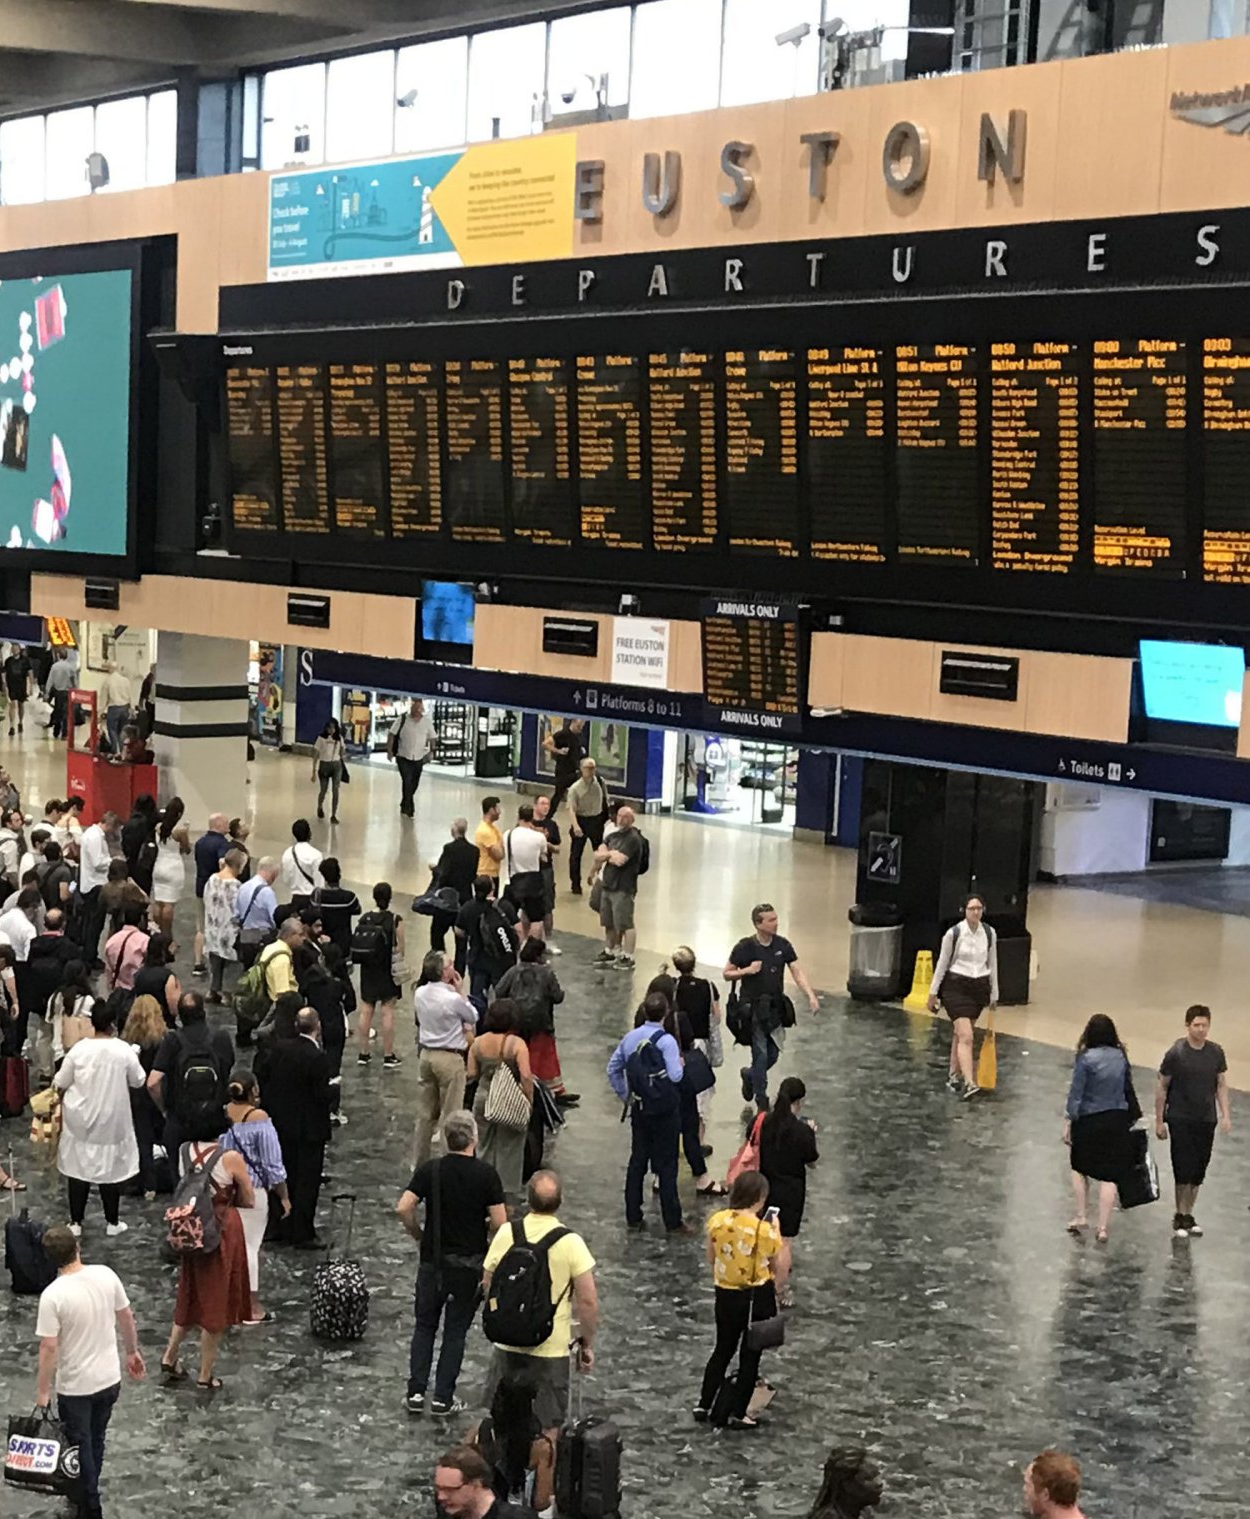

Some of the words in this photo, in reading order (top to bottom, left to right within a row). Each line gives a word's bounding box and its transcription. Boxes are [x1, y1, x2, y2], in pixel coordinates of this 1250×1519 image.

[574, 109, 1027, 220] EUSTON
[448, 225, 1220, 309] DEPARTURES
[1033, 342, 1069, 354] Platform
[1138, 340, 1177, 352] Platform
[1094, 357, 1144, 369] Manchester
[1147, 356, 1166, 368] Picc
[716, 602, 755, 617] ARRIVALS
[756, 604, 780, 618] ONLY
[616, 636, 633, 650] FREE
[634, 638, 665, 652] EUSTON
[616, 653, 647, 666] STATION
[601, 693, 646, 713] Platforms
[647, 697, 654, 714] 8
[656, 700, 668, 716] to
[669, 701, 682, 717] 11
[720, 709, 759, 727] ARRIVALS
[760, 714, 783, 728] ONLY
[1070, 760, 1105, 777] Toilets
